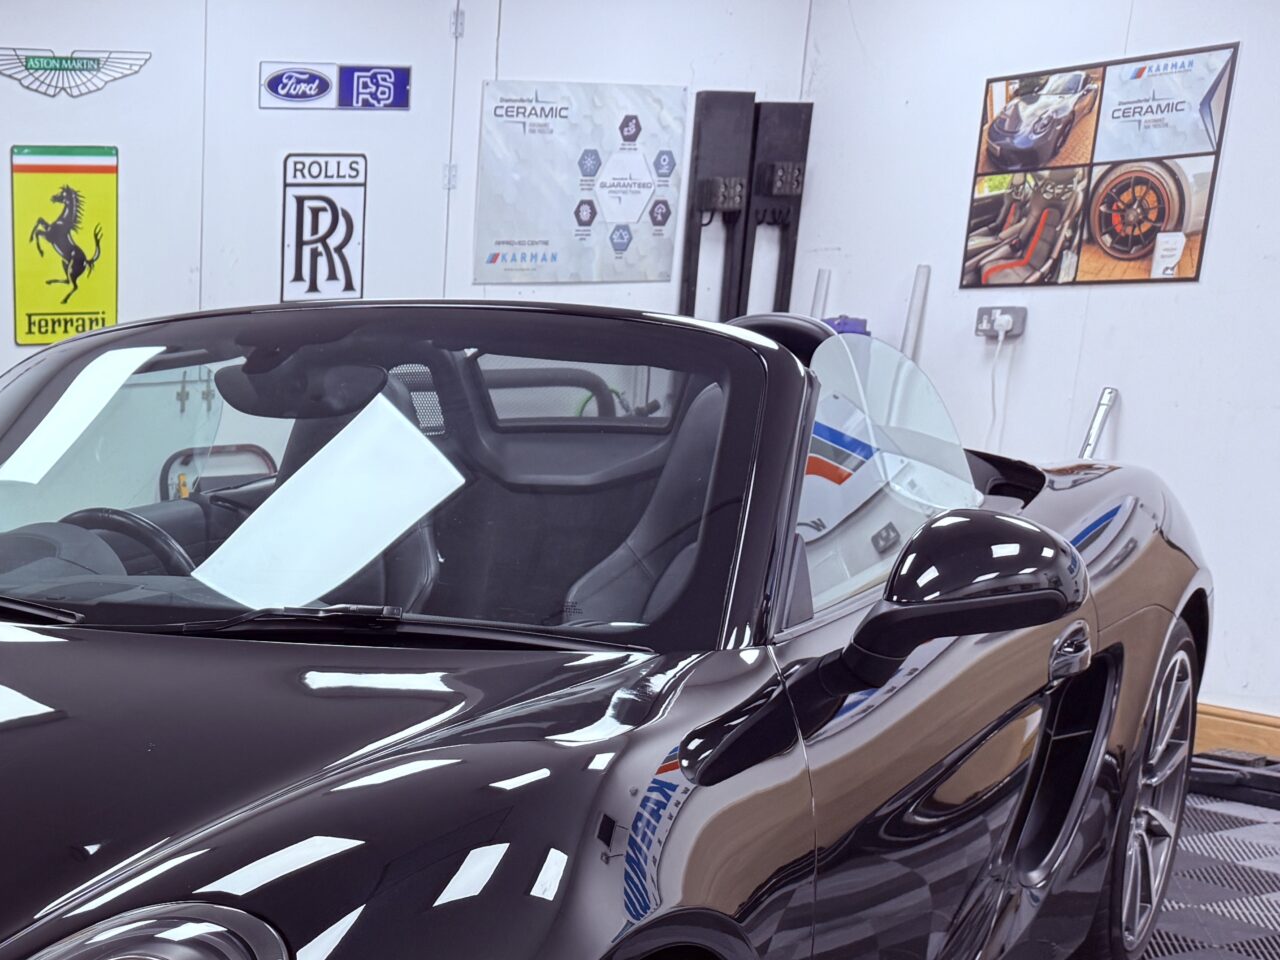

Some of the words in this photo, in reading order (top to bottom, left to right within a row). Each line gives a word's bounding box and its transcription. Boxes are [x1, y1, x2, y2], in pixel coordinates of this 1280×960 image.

[27, 57, 60, 69] ASTON
[62, 58, 98, 69] MARTIN
[1147, 59, 1194, 73] KARMAN
[277, 72, 319, 96] Ford
[353, 69, 395, 107] RS
[493, 105, 569, 119] CERAMIC
[1112, 101, 1186, 119] CERAMIC
[292, 160, 360, 179] ROLLS
[599, 181, 653, 189] GUARANTEED
[500, 252, 558, 264] KARMAN
[25, 311, 106, 335] Ferrari
